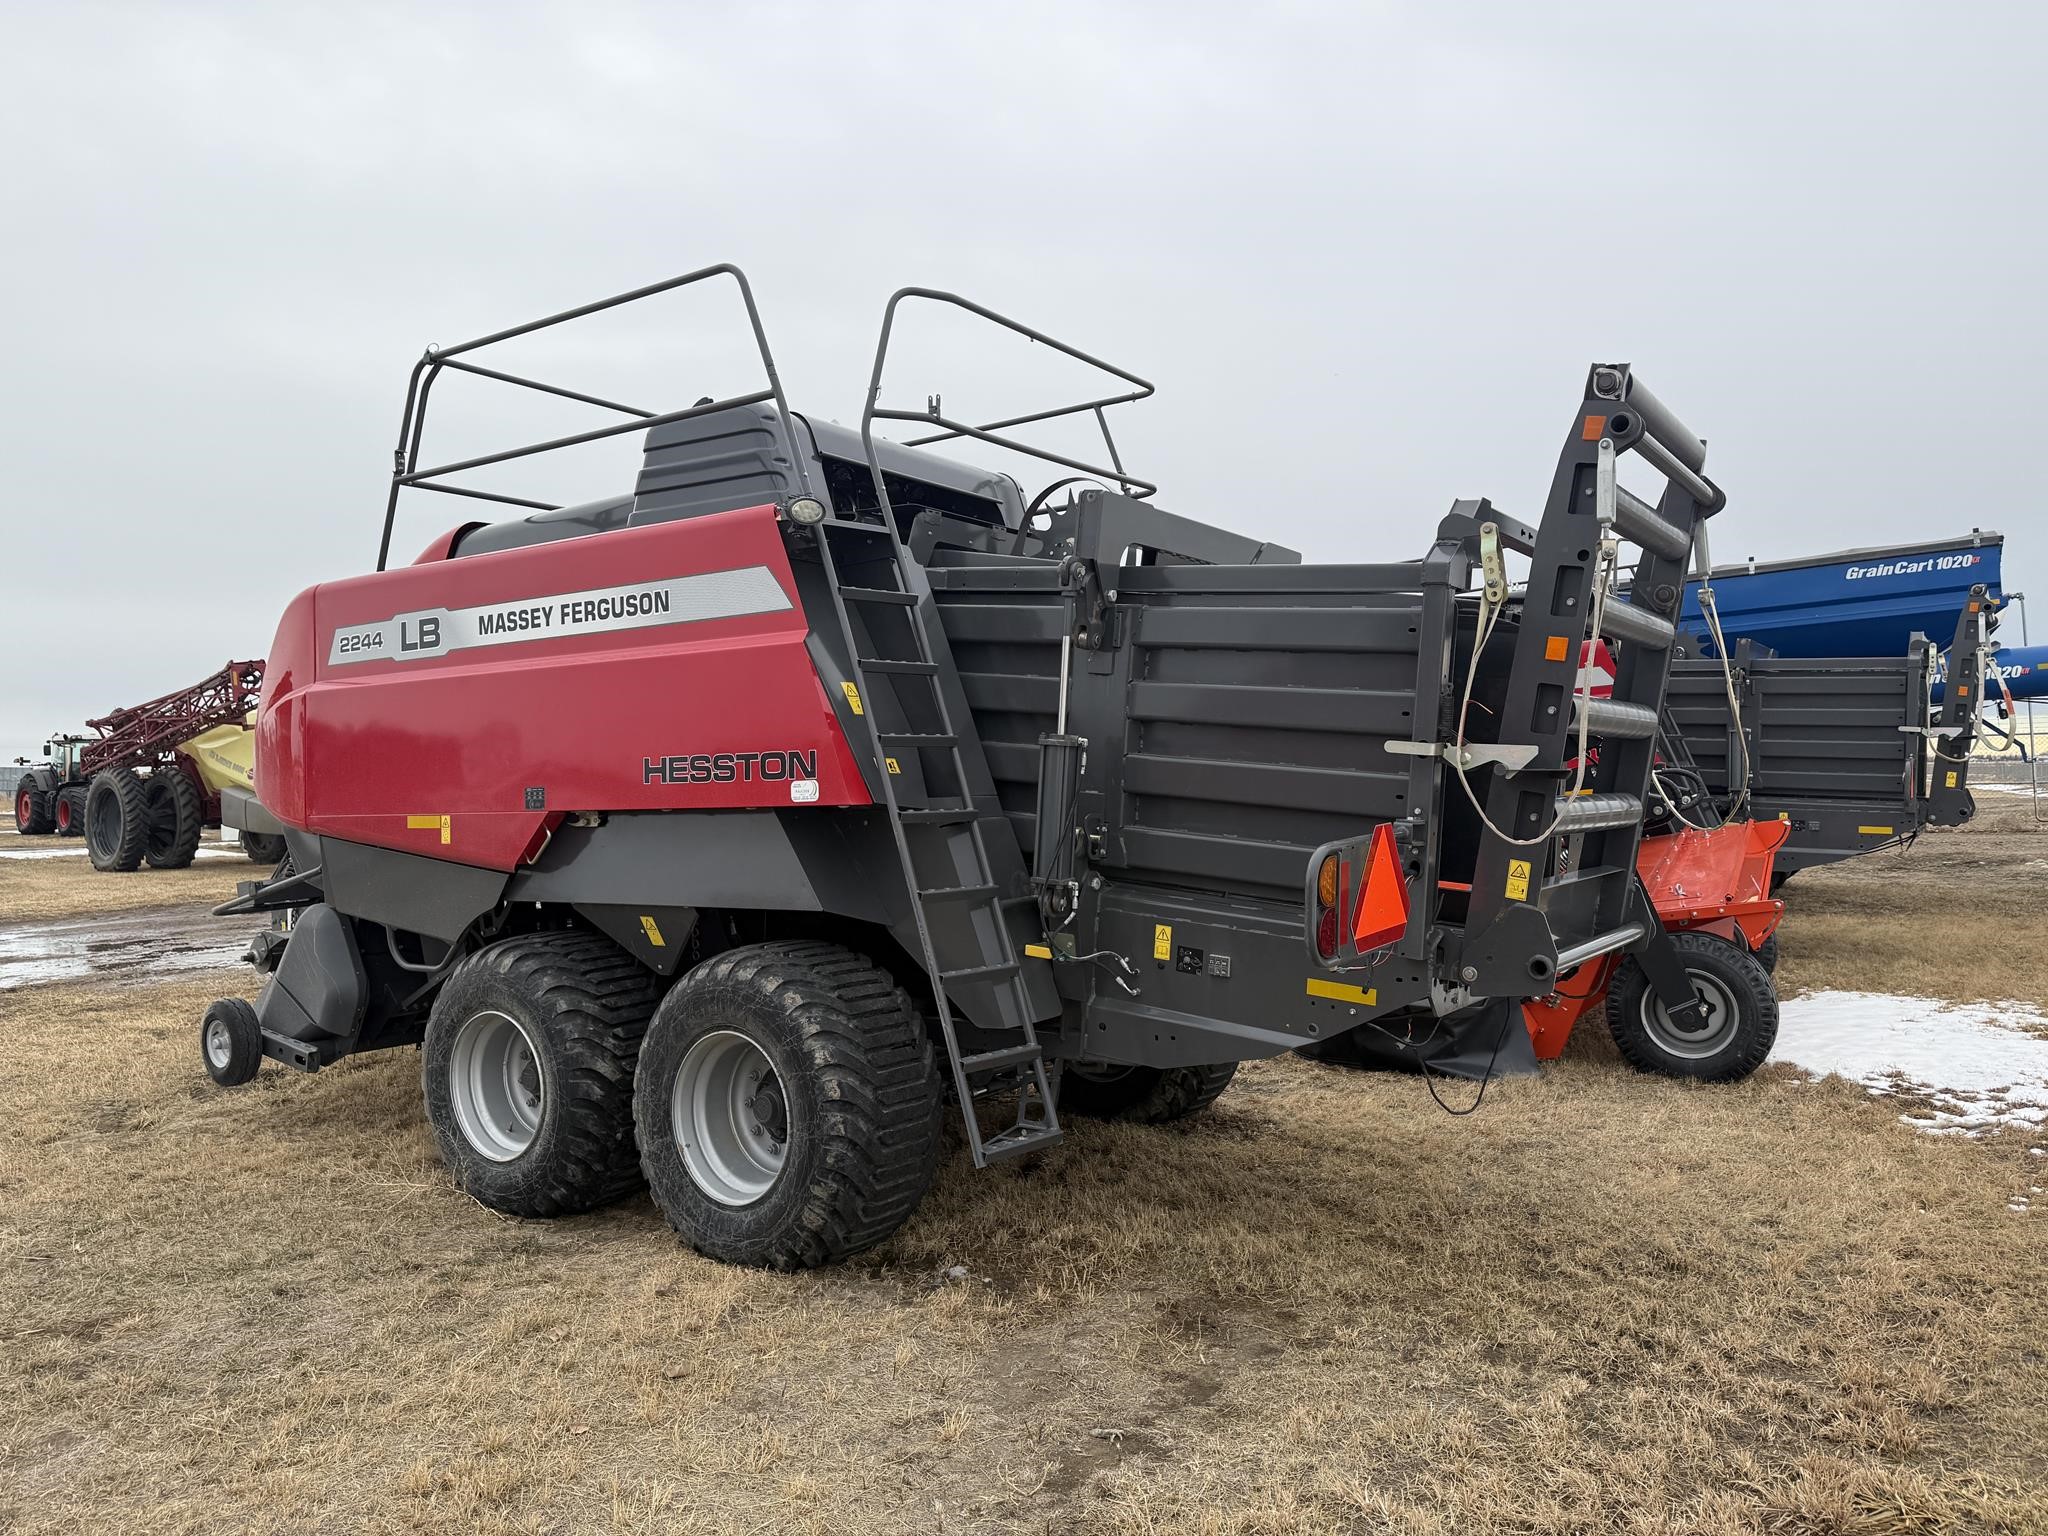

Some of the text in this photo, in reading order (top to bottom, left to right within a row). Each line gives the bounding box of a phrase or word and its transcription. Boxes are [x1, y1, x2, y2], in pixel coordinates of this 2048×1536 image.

[1936, 554, 1973, 570] 1020
[339, 589, 671, 654] 2244 LB MASSEY FERGUSON
[643, 749, 817, 785] HESSTON
